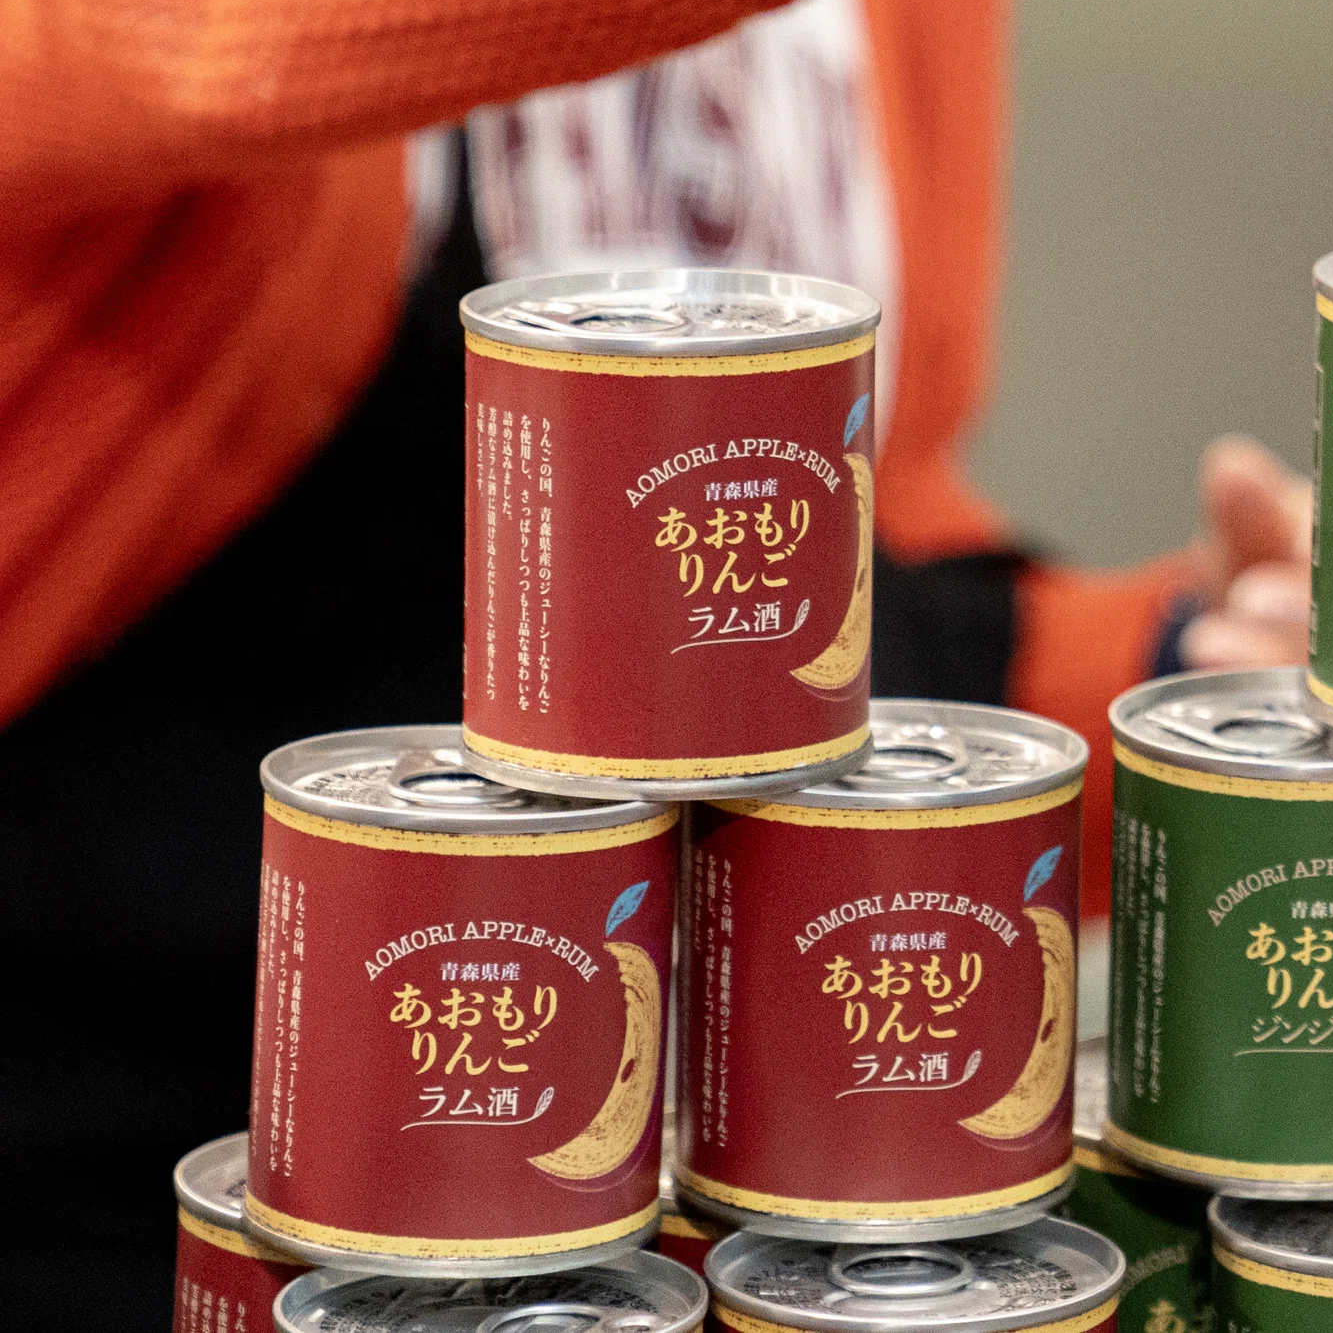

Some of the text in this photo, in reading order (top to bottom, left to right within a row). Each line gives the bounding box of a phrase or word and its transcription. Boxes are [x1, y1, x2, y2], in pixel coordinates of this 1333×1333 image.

[625, 443, 719, 509] AOMORI
[704, 478, 778, 501] 青森県産
[655, 499, 810, 552] あおもり
[679, 543, 797, 598] りんご
[688, 601, 781, 639] ラム酒
[1206, 864, 1288, 927] AOMORI
[794, 896, 885, 955] AOMORI
[869, 931, 947, 952] 青森県産
[363, 923, 457, 981] AOMORI
[440, 962, 520, 982] 青森県産
[821, 952, 983, 1000] あおもり
[389, 983, 558, 1031] あおもり
[844, 996, 967, 1045] りんご
[411, 1029, 540, 1076] りんご
[852, 1052, 949, 1086] ラム酒
[419, 1086, 520, 1117] ラム酒
